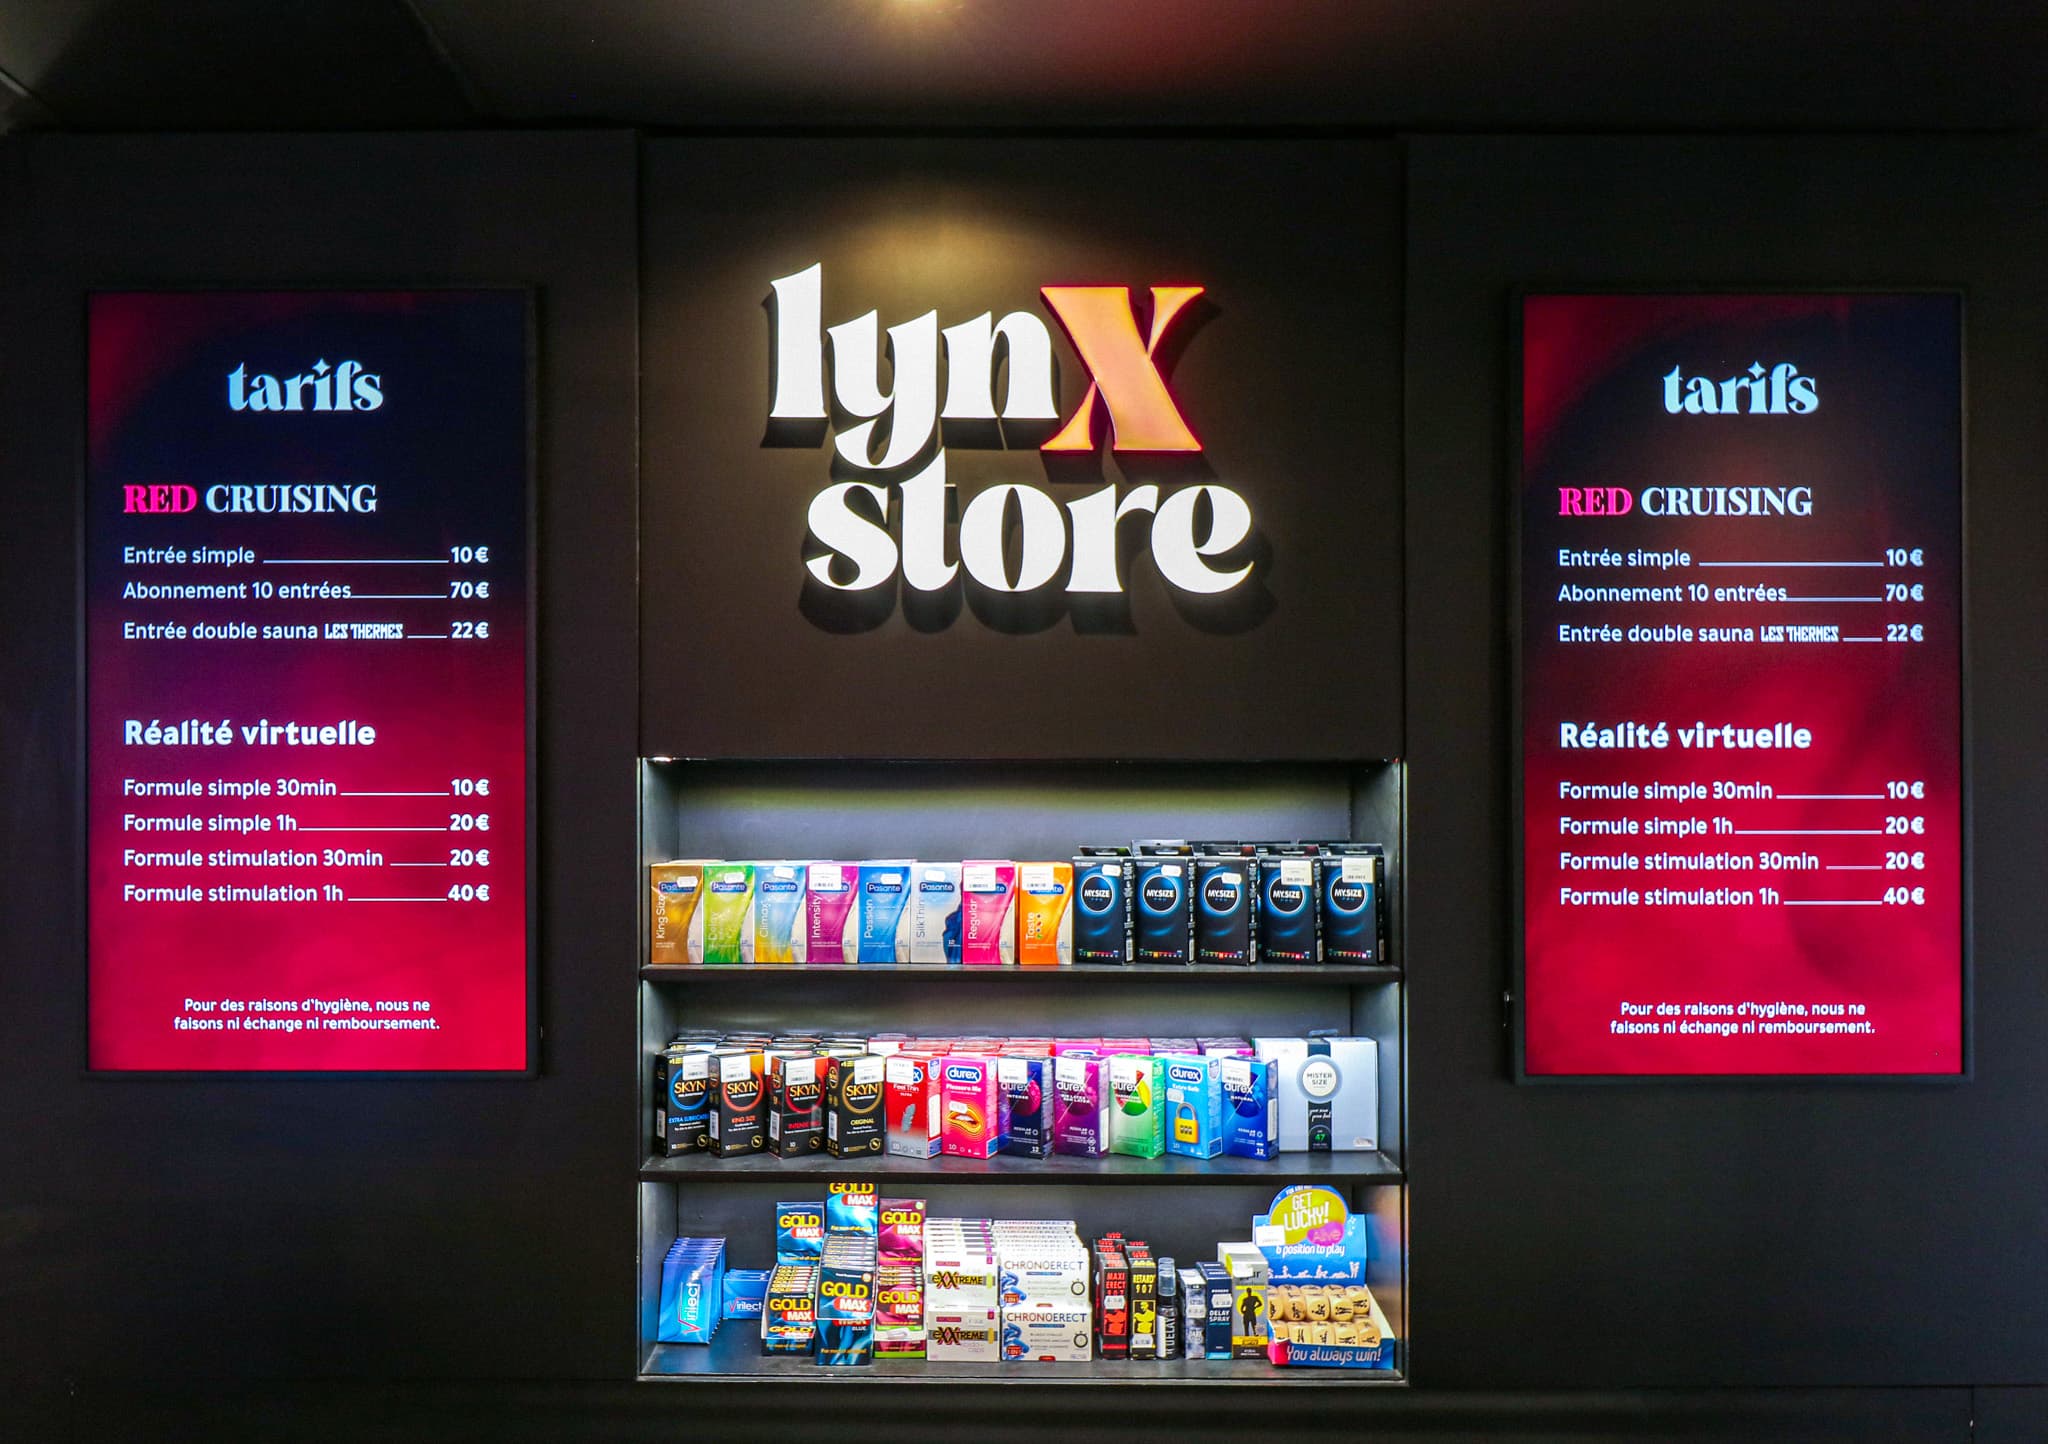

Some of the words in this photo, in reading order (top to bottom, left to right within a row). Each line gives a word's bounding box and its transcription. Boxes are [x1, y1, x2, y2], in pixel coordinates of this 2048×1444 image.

[229, 358, 383, 411] tarifs
[1664, 361, 1818, 414] tarifs
[123, 485, 197, 513] RED
[205, 485, 377, 513] CRUISING
[1558, 487, 1633, 516] RED
[1640, 487, 1812, 516] CRUISING
[806, 447, 1254, 593] store
[124, 546, 186, 564] Entrée
[193, 546, 255, 567] simple
[1559, 549, 1622, 567] Entrée
[1628, 549, 1690, 570] simple
[124, 581, 246, 599] Abonnement
[253, 582, 273, 599] 10
[279, 581, 352, 599] entrées
[1559, 584, 1682, 602] Abonnement
[1688, 584, 1709, 601] 10
[1714, 584, 1787, 602] entrées
[124, 622, 187, 640] Entrée
[193, 622, 257, 640] double
[263, 626, 318, 640] sauna
[324, 623, 348, 640] LES
[351, 623, 403, 640] THERMES
[1559, 624, 1622, 642] Entrée
[1628, 624, 1693, 642] double
[1699, 628, 1754, 642] sauna
[1760, 626, 1784, 642] LES
[1786, 626, 1839, 642] THERMES
[125, 719, 233, 746] Réalité
[242, 719, 376, 746] virtuelle
[1560, 722, 1669, 748] Réalité
[1678, 722, 1812, 748] virtuelle
[124, 779, 202, 796] Formule
[208, 779, 271, 800] simple
[277, 779, 337, 796] 30min
[1560, 782, 1639, 799] Formule
[1644, 782, 1707, 803] simple
[1713, 781, 1772, 799] 30min
[124, 814, 202, 831] Formule
[208, 814, 271, 835] simple
[277, 814, 297, 831] 1h
[1560, 817, 1639, 835] Formule
[1644, 817, 1707, 838] simple
[1713, 817, 1733, 834] 1h
[124, 850, 202, 867] Formule
[208, 850, 317, 867] stimulation
[323, 849, 383, 866] 30min
[1560, 852, 1639, 870] Formule
[1644, 852, 1753, 870] stimulation
[1759, 852, 1819, 870] 30min
[124, 885, 202, 902] Formule
[208, 885, 317, 902] stimulation
[323, 885, 343, 902] 1h
[920, 883, 953, 891] Pasante
[1560, 888, 1639, 905] Formule
[1644, 888, 1753, 905] stimulation
[1759, 888, 1779, 905] 1h
[811, 895, 823, 938] Intensity
[864, 899, 873, 939] Passion
[968, 899, 980, 939] Regular
[656, 916, 669, 939] King
[184, 998, 217, 1012] Pour
[221, 998, 245, 1012] des
[248, 998, 298, 1012] raisons
[376, 1001, 409, 1012] nous
[413, 1001, 430, 1012] ne
[1621, 1002, 1653, 1016] Pour
[1657, 1002, 1681, 1016] des
[1685, 1002, 1734, 1016] raisons
[1812, 1004, 1845, 1016] nous
[1849, 1004, 1866, 1016] ne
[174, 1017, 223, 1030] faisons
[228, 1017, 239, 1030] ni
[243, 1017, 303, 1032] échange
[307, 1017, 319, 1030] ni
[323, 1017, 440, 1030] remboursement.
[1610, 1020, 1660, 1033] faisons
[1664, 1020, 1676, 1033] ni
[1680, 1020, 1738, 1036] échange
[1743, 1020, 1755, 1033] ni
[1759, 1020, 1875, 1033] remboursement.
[949, 1067, 978, 1082] durex
[1171, 1067, 1199, 1082] durex
[674, 1081, 706, 1094] SKYN
[727, 1081, 759, 1095] SKYN
[789, 1084, 821, 1097] SKYN
[846, 1084, 878, 1097] SKYN
[829, 1183, 874, 1194] GOLD
[847, 1195, 873, 1205] MAX
[1292, 1192, 1313, 1211] GET
[779, 1215, 820, 1228] GOLD
[881, 1212, 922, 1224] GOLD
[1284, 1201, 1330, 1231] LUCKY!
[795, 1228, 820, 1237] MAX
[897, 1225, 920, 1234] MAX
[1282, 1244, 1315, 1258] position
[1316, 1244, 1326, 1254] to
[1326, 1244, 1345, 1258] play
[1105, 1281, 1126, 1289] ERECT
[1107, 1272, 1125, 1281] MAXI
[821, 1281, 869, 1299] GOLD
[878, 1291, 920, 1304] GOLD
[769, 1298, 812, 1311] GOLD
[839, 1299, 867, 1311] MAX
[895, 1304, 919, 1313] MAX
[787, 1311, 812, 1321] MAX
[1006, 1312, 1087, 1322] CHRONOERECT
[1286, 1345, 1308, 1361] You
[1310, 1346, 1354, 1365] always
[1355, 1348, 1382, 1362] win!
